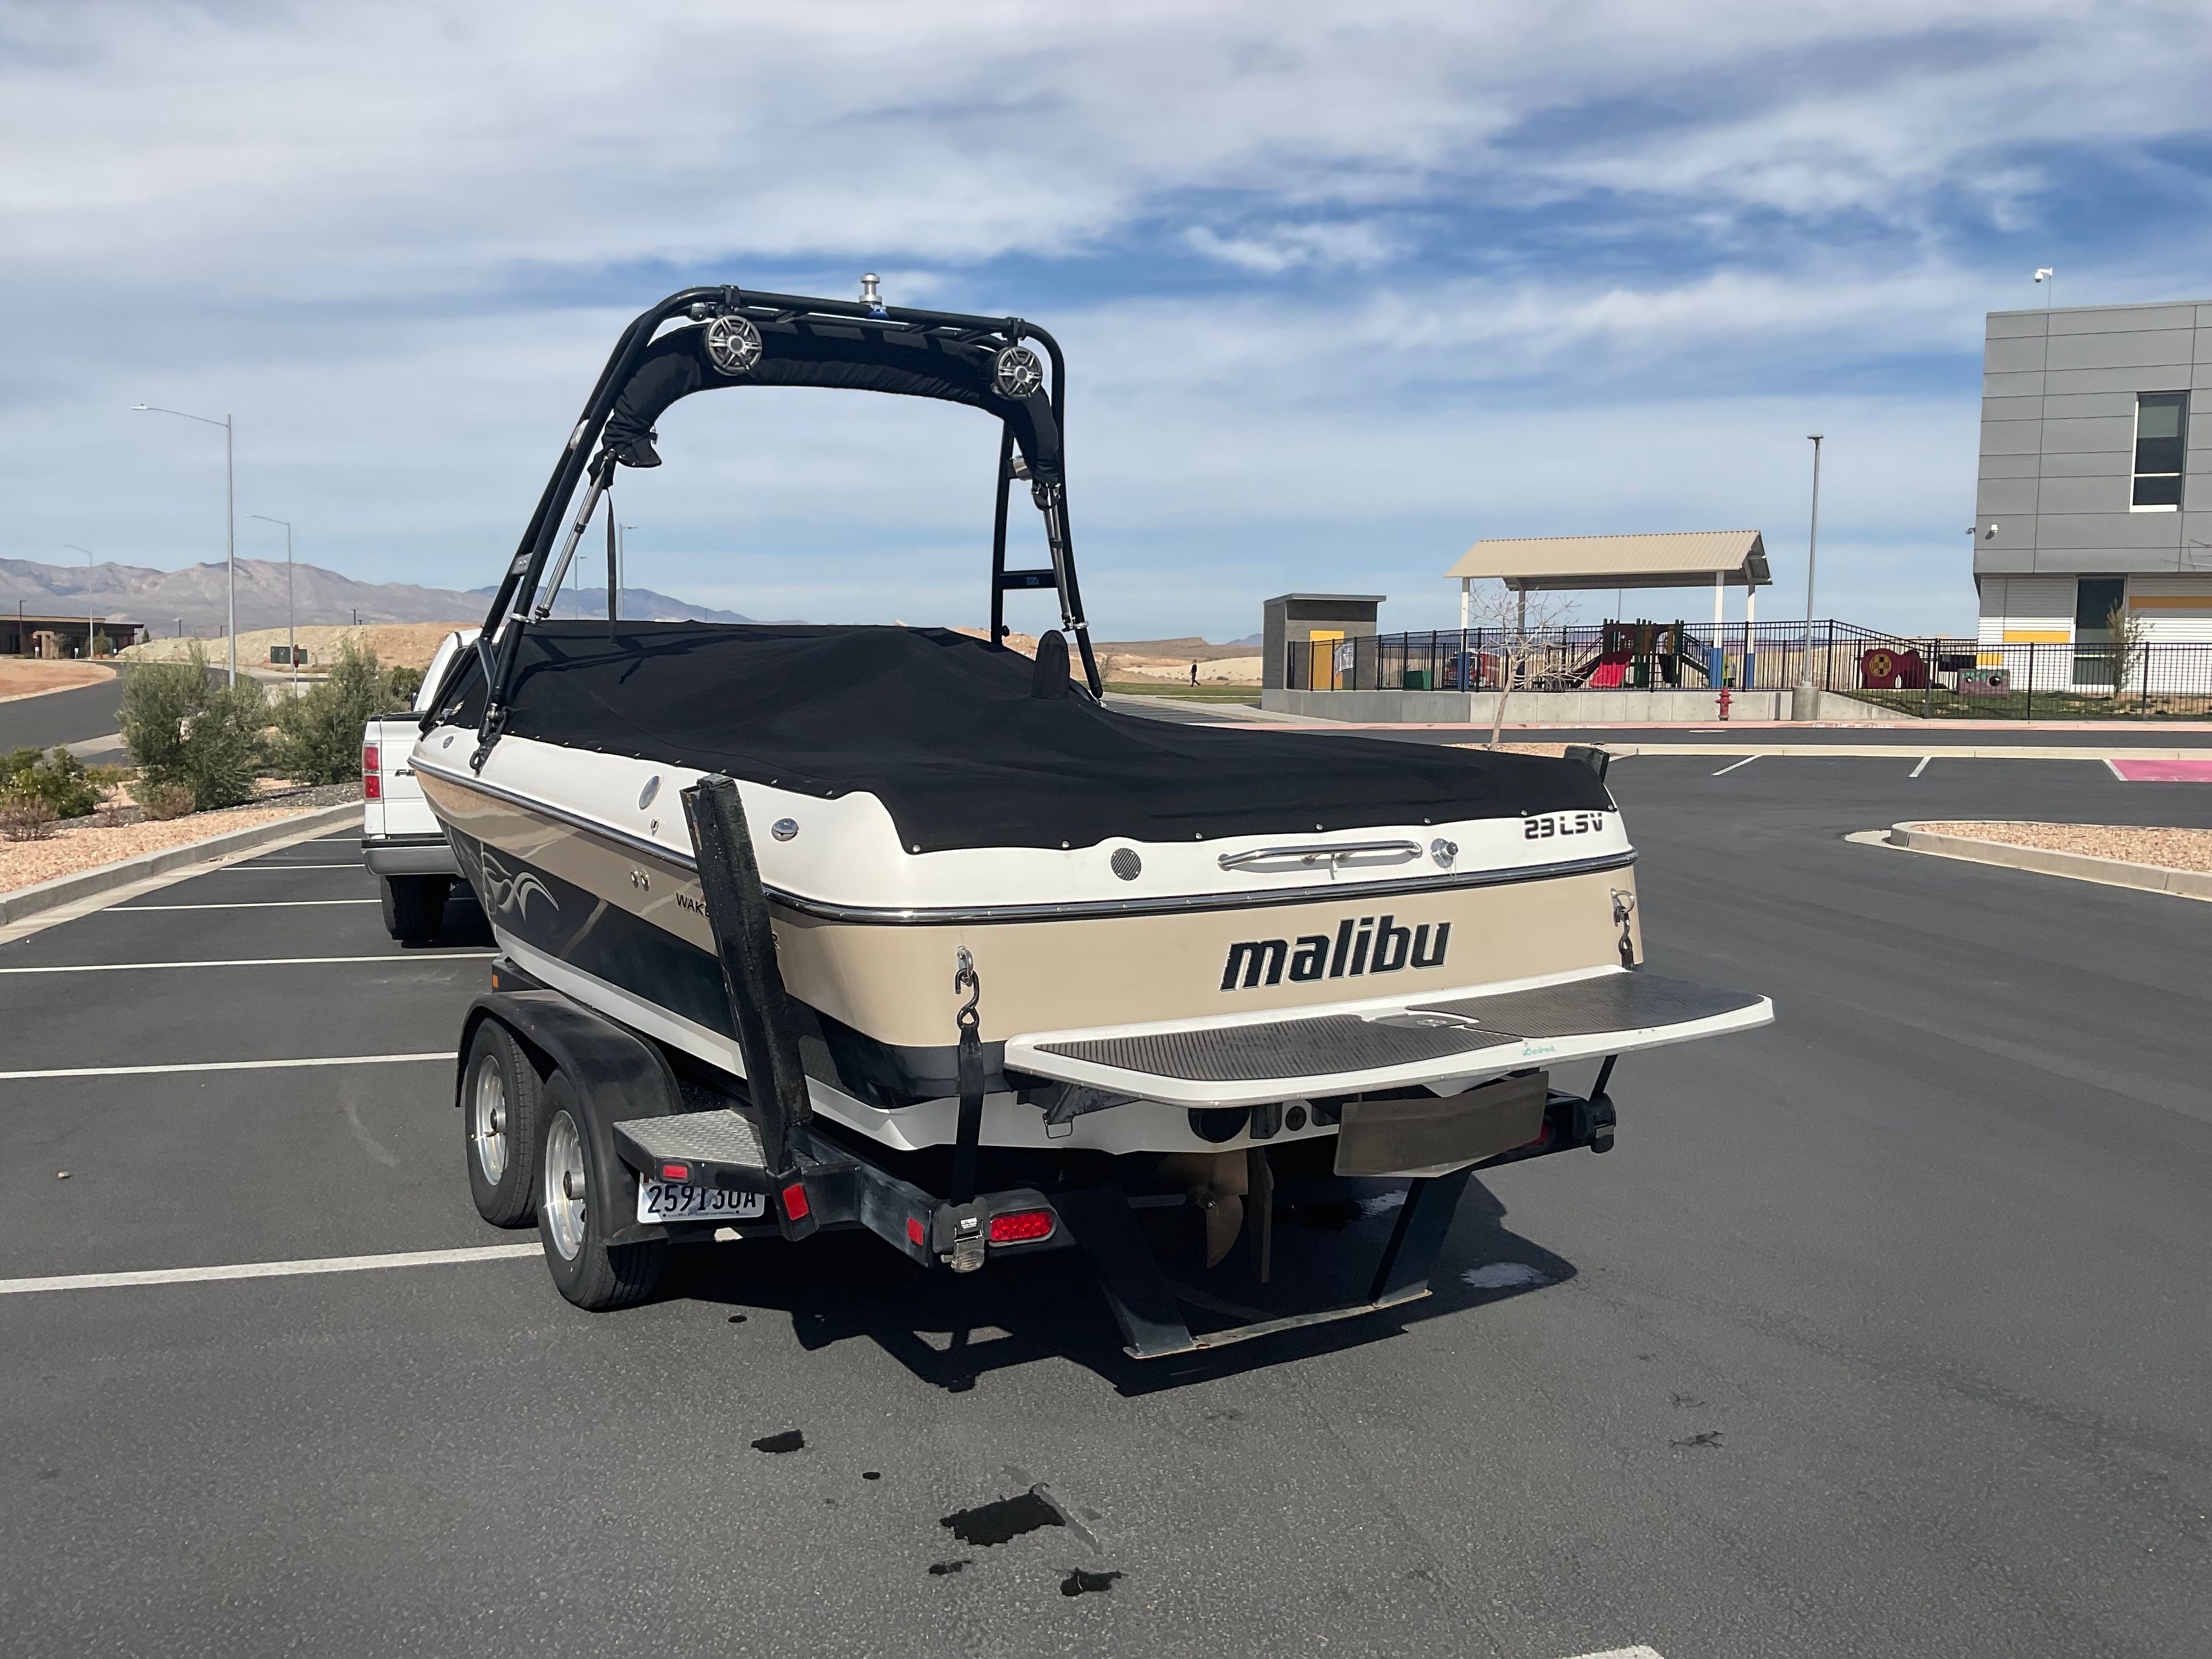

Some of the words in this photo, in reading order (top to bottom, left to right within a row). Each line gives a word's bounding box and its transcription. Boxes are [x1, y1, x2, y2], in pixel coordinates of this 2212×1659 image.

[1524, 817, 1554, 840] 23
[1559, 812, 1602, 836] LSV
[1219, 915, 1453, 991] malibu
